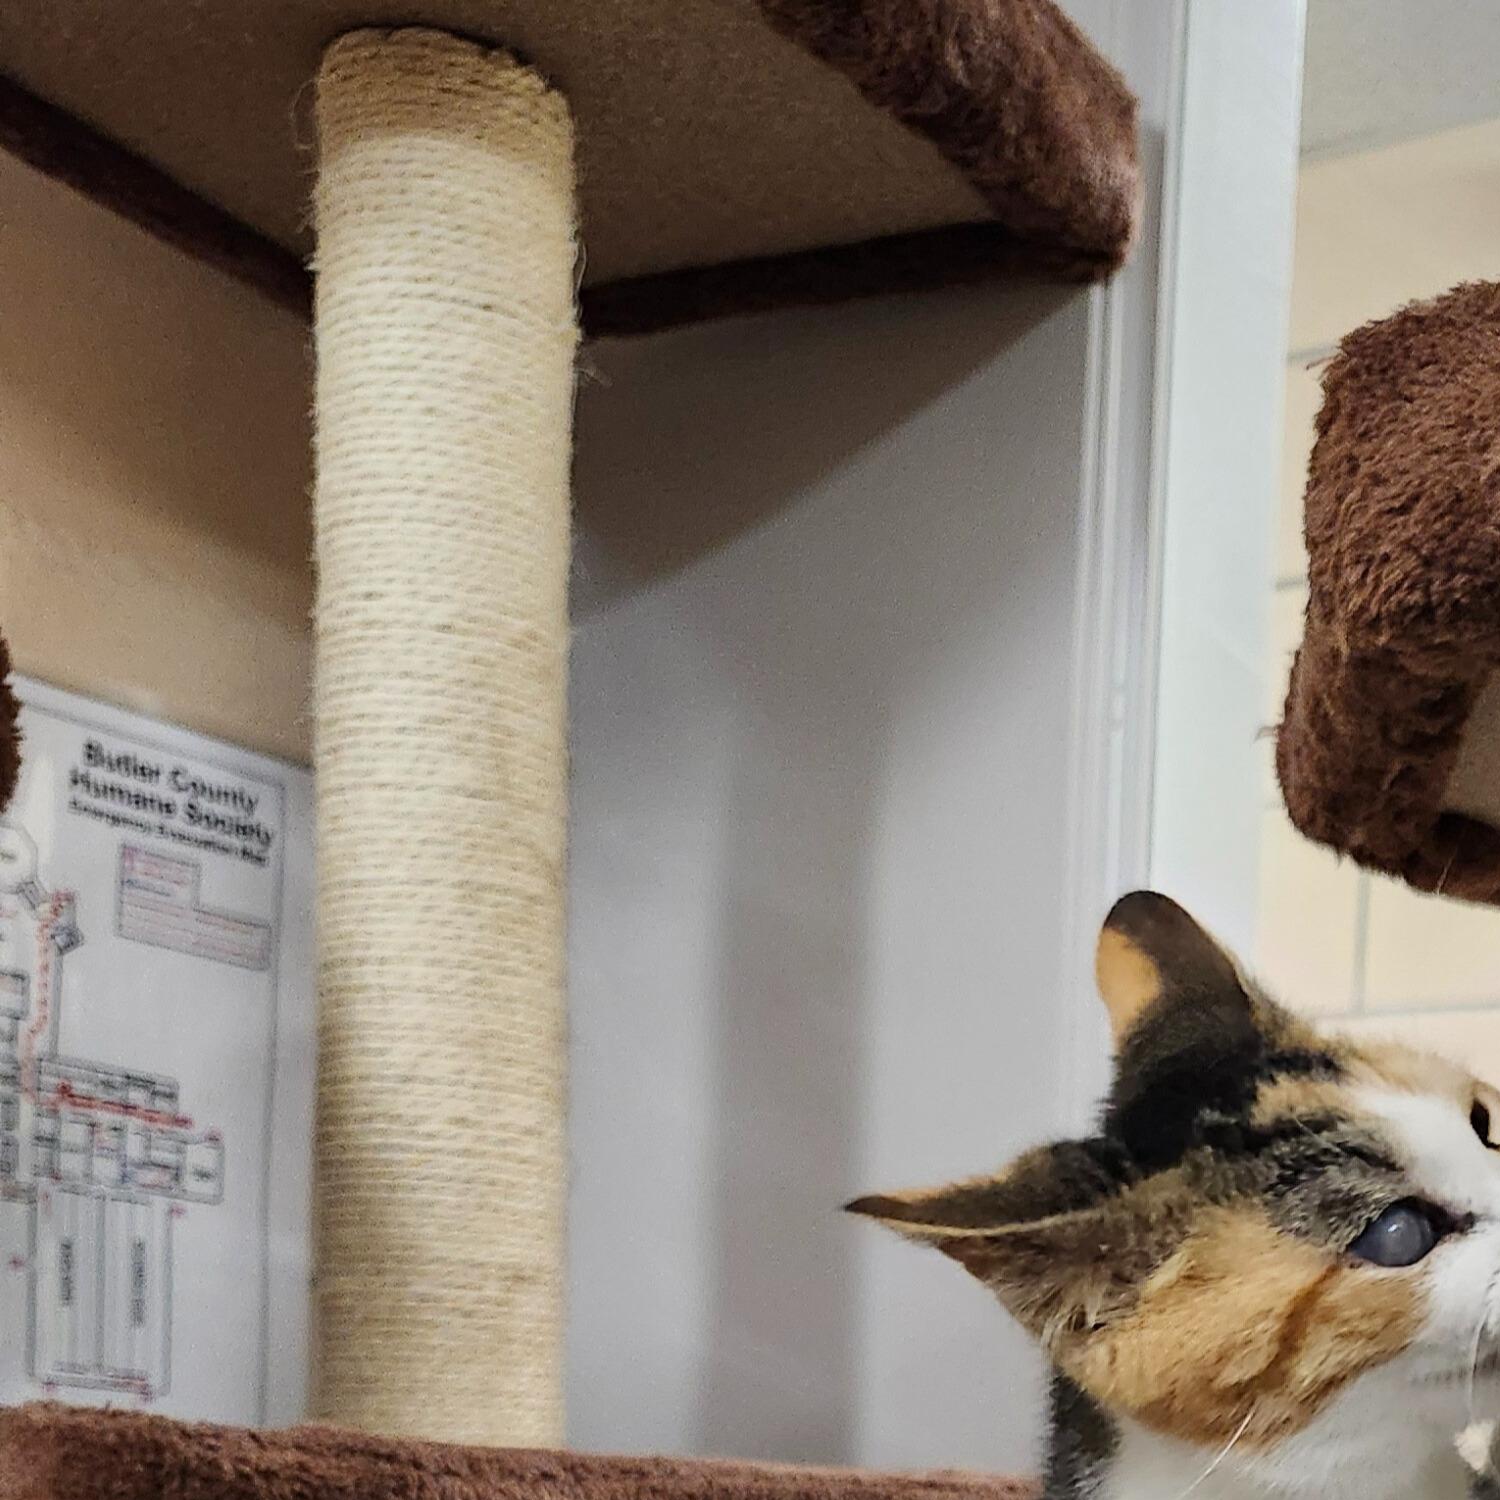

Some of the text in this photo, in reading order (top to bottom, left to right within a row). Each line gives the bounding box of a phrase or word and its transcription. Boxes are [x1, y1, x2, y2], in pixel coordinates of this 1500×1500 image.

[69, 767, 272, 847] Humane Society
[85, 740, 257, 816] Butler County
